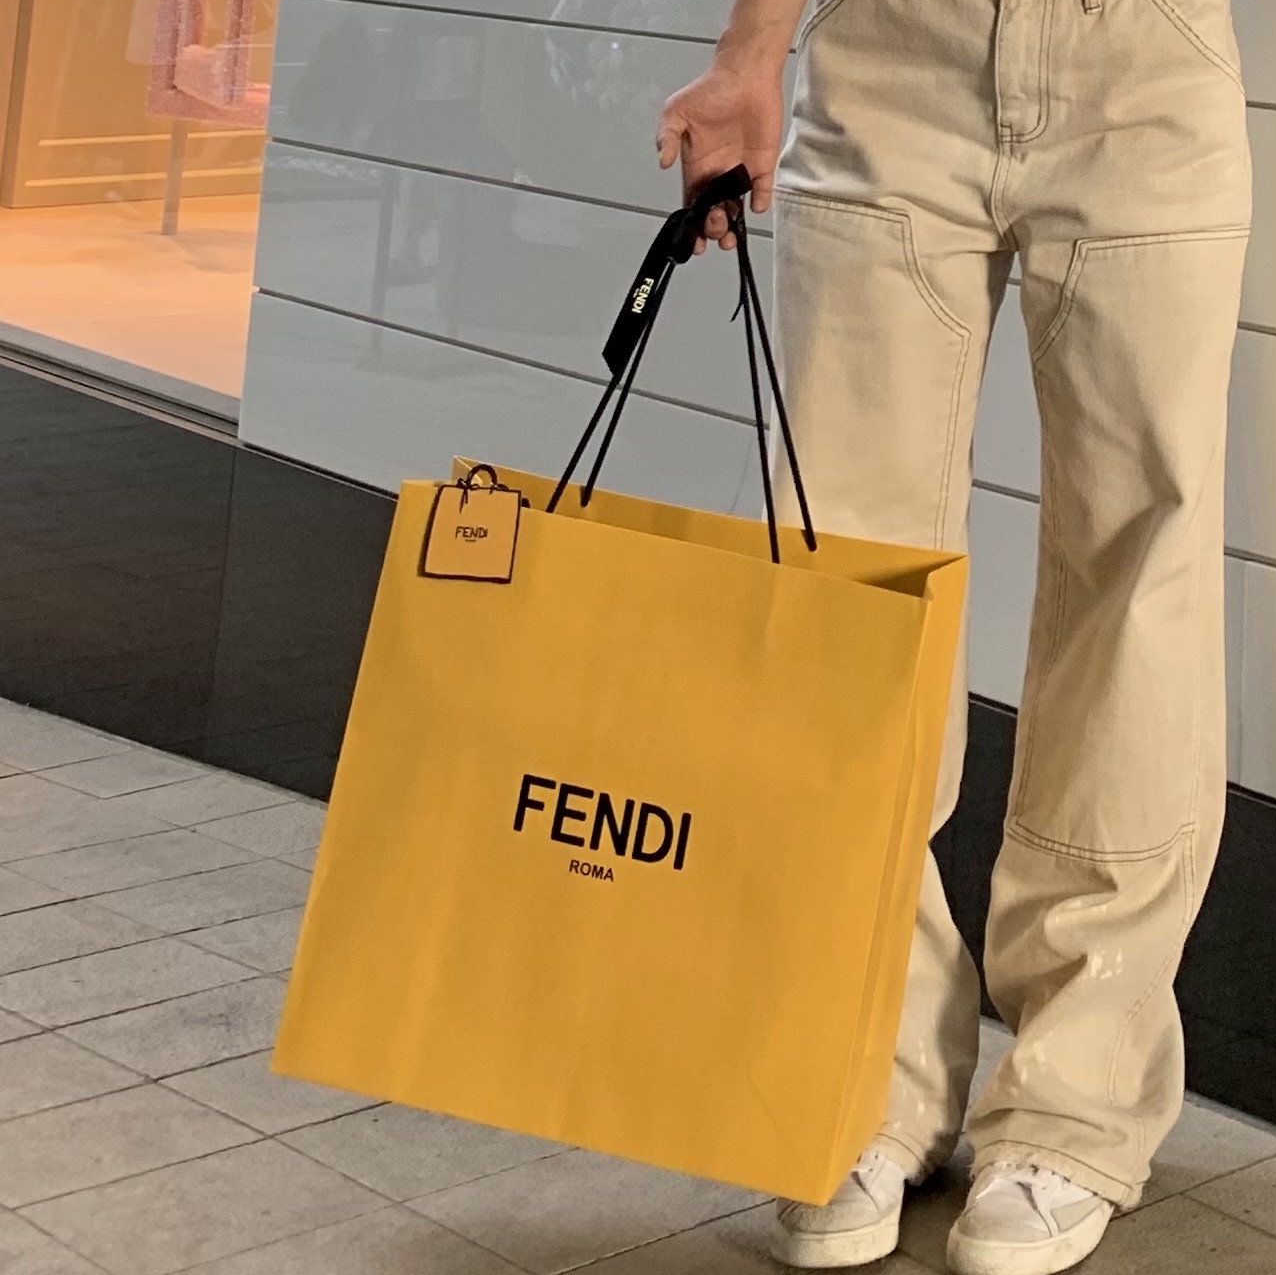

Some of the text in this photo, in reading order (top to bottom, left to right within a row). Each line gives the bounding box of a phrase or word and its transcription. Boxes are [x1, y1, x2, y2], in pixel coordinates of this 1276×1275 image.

[631, 278, 655, 313] FENDI
[455, 526, 488, 539] FENDI
[513, 774, 692, 870] FENDI
[569, 860, 614, 882] ROMA
